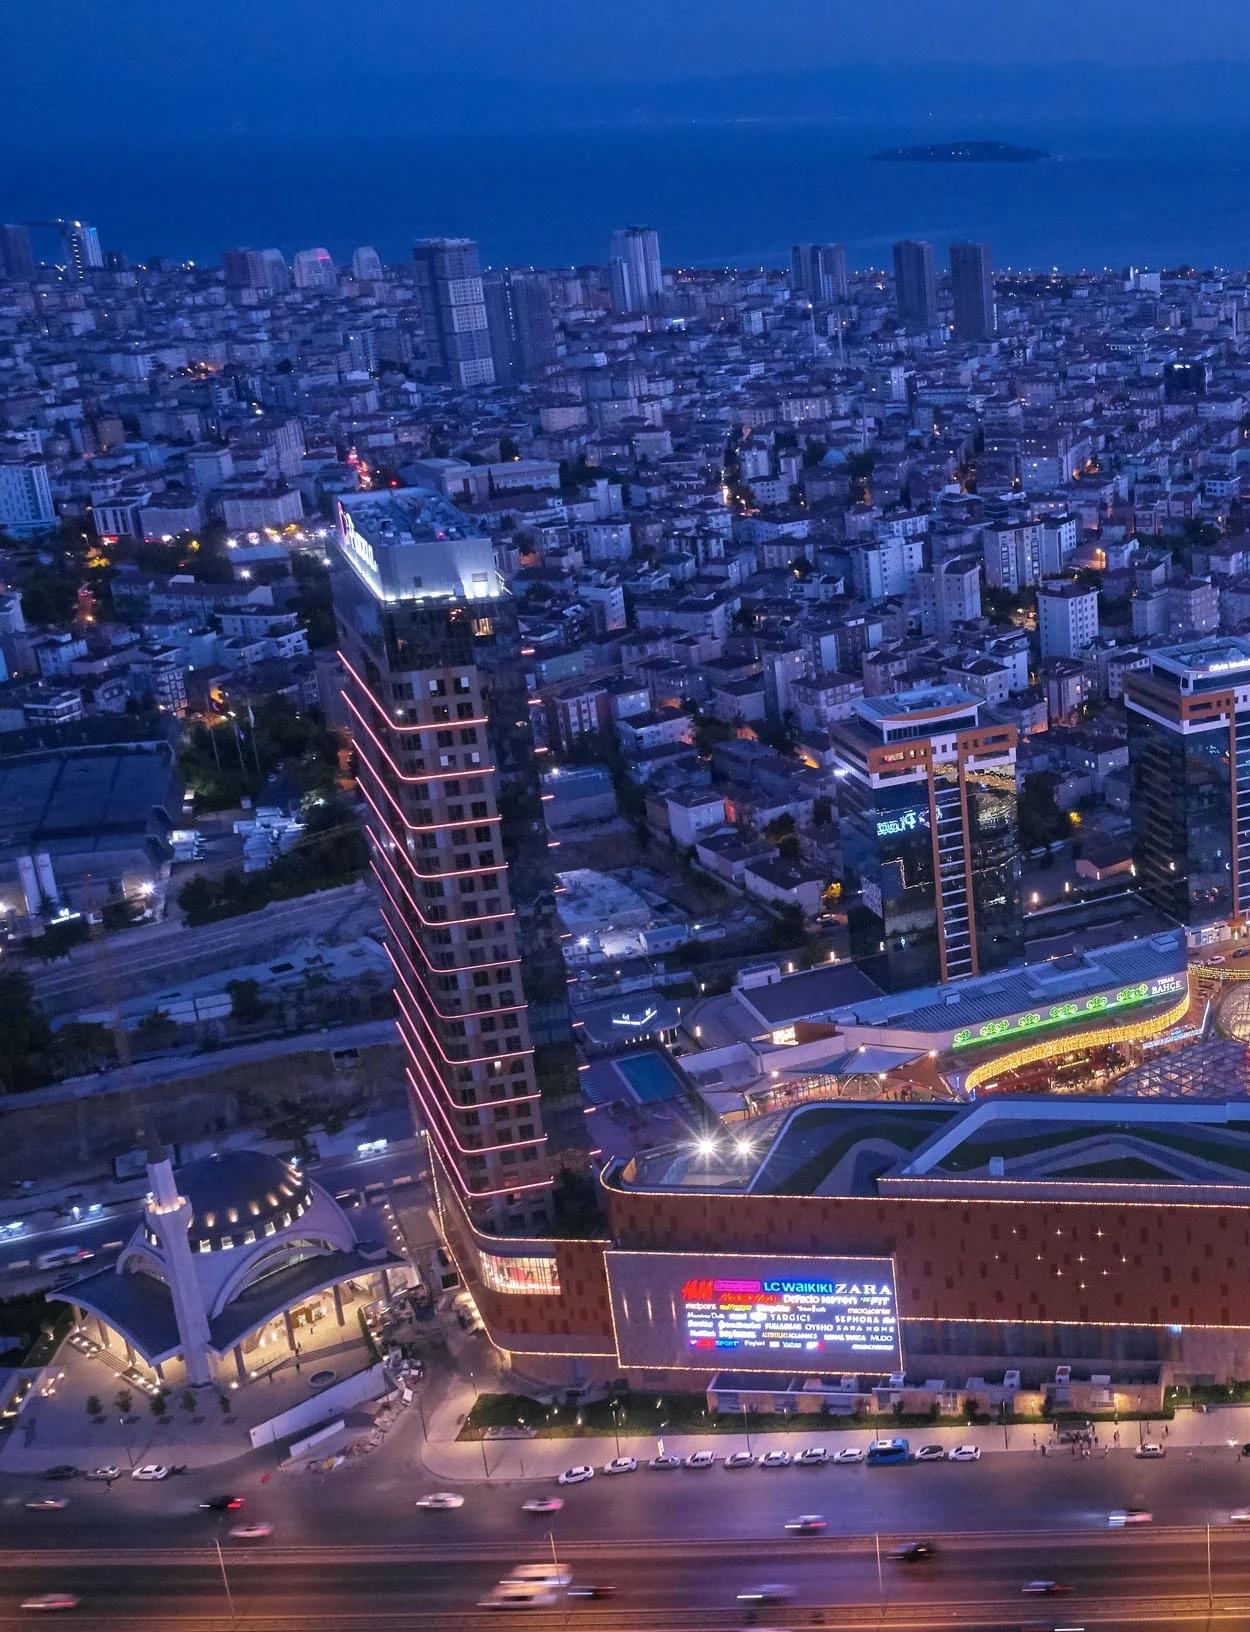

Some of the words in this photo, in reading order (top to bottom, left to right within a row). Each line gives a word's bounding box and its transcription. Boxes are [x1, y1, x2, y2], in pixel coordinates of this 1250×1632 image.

[1151, 980, 1182, 995] BAHÇE
[763, 1282, 780, 1292] LC
[835, 1284, 893, 1295] ZARA
[835, 1315, 880, 1324] SEPHORA
[870, 1334, 893, 1342] MUDO
